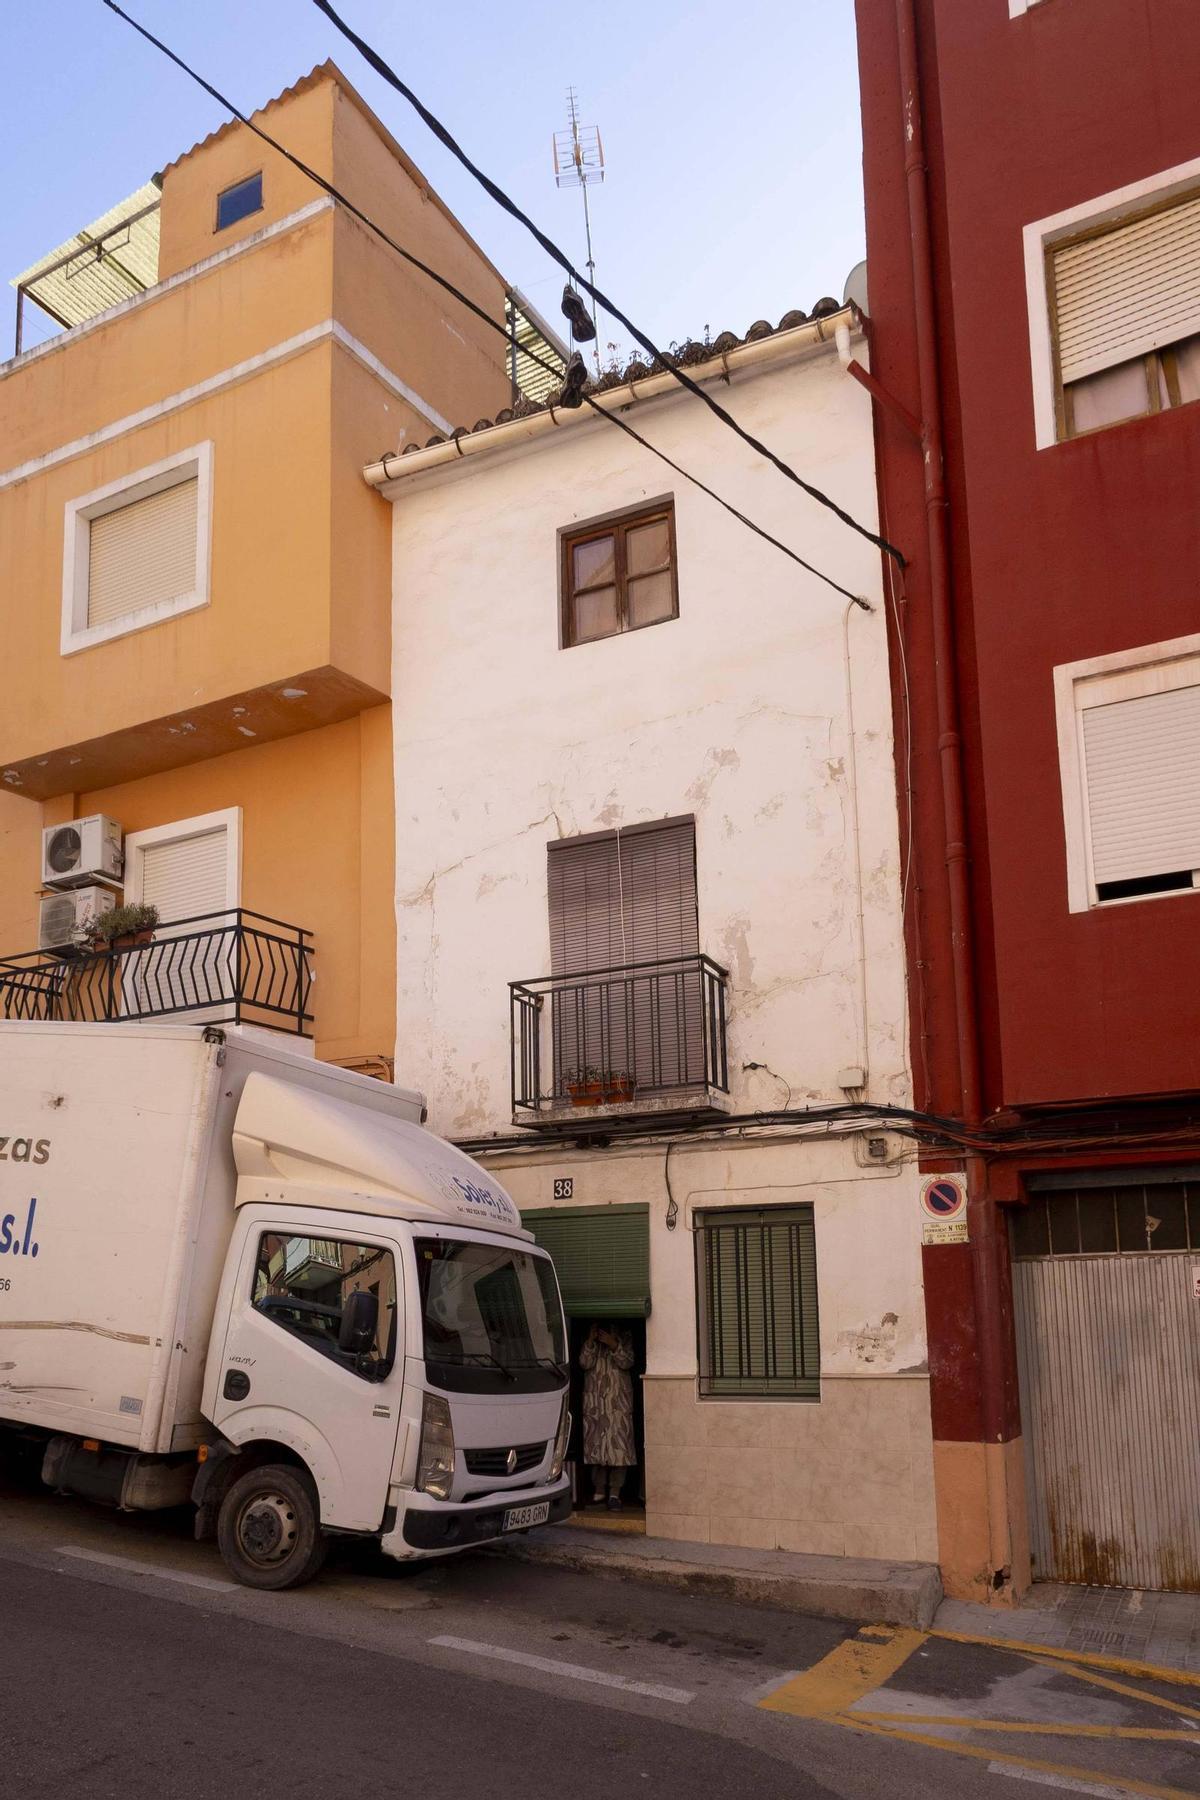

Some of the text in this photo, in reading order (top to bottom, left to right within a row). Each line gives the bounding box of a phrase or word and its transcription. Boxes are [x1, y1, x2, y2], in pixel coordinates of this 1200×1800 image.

[555, 1180, 571, 1196] 38
[510, 1504, 548, 1526] 9483 GRN
